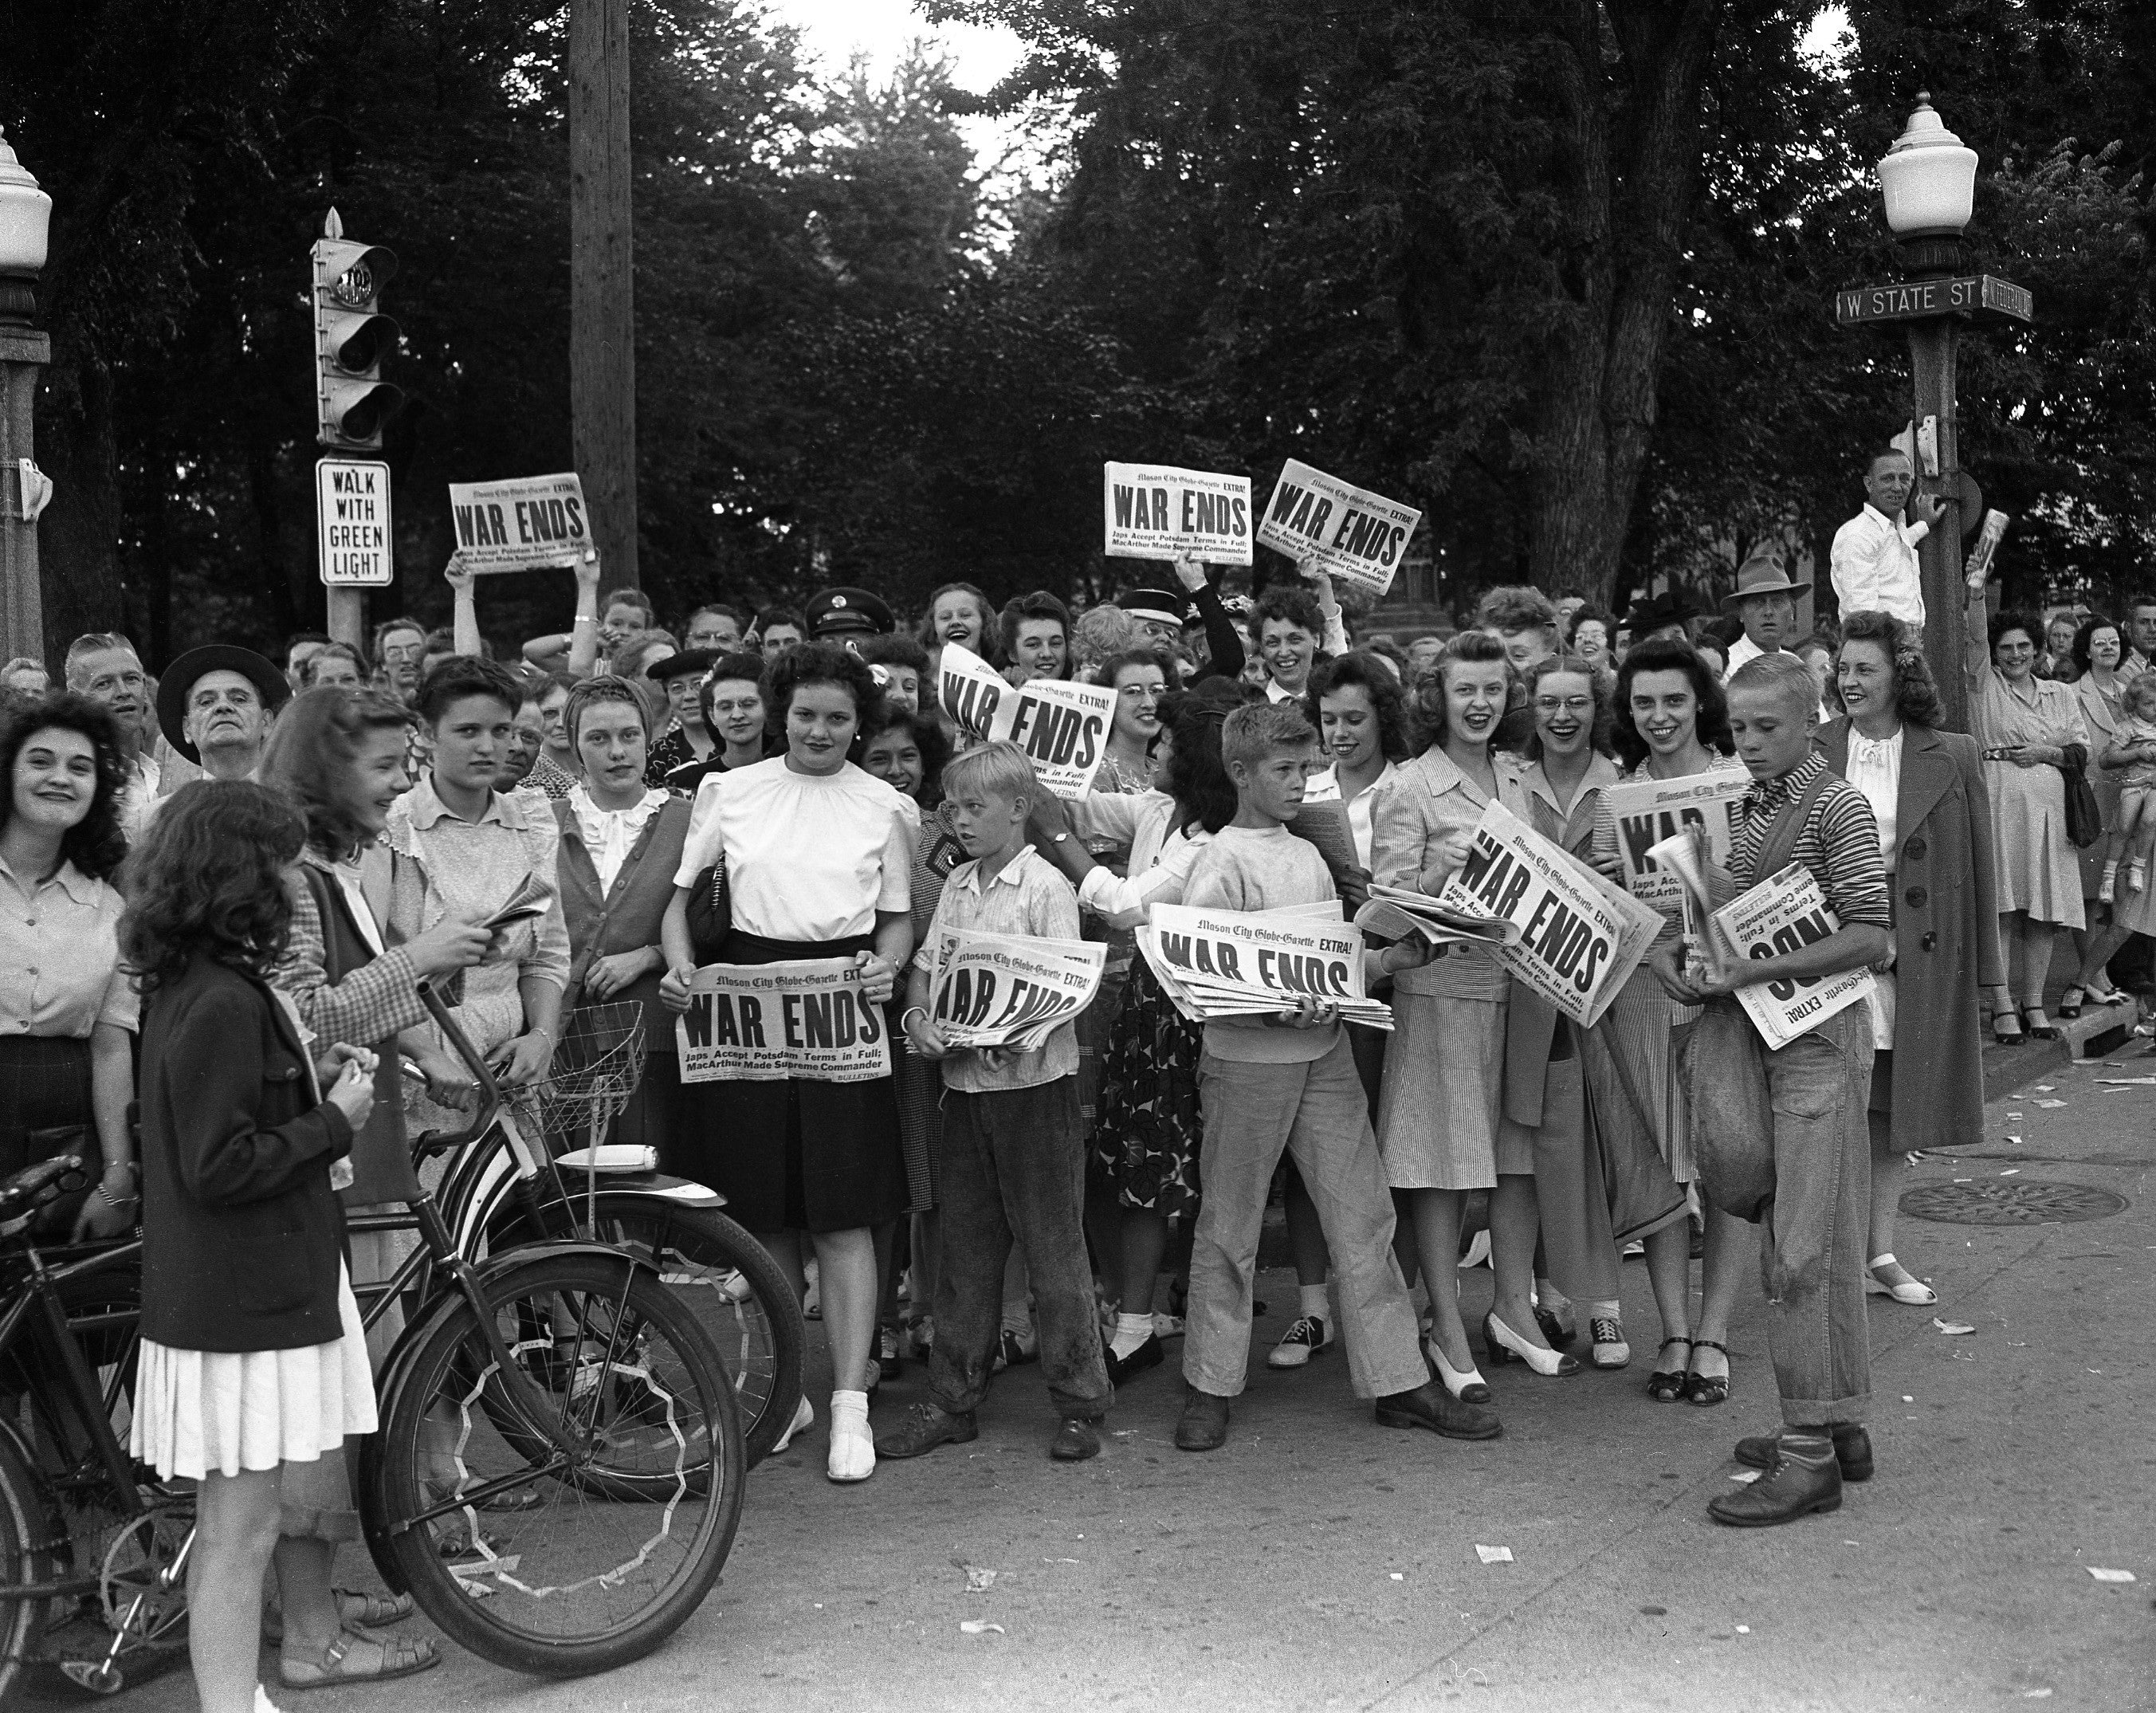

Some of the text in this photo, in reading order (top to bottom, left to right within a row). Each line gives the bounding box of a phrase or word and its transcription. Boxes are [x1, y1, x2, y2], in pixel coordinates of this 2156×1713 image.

[1848, 281, 1976, 317] W STATE ST
[332, 471, 375, 493] WALK
[1223, 483, 1246, 493] EXTRA!
[336, 499, 375, 520] WITH
[1113, 484, 1247, 537] WAR ENDS
[1390, 509, 1413, 525] EXTRA!
[454, 497, 584, 547] WAR ENDS
[1271, 481, 1405, 567] WAR ENDS
[330, 525, 383, 548] GREEN
[1112, 539, 1149, 548] MacArthur
[1172, 543, 1203, 552] Supreme
[1204, 545, 1247, 554] Commander
[1131, 532, 1156, 541] Accept
[1262, 529, 1296, 549] MacArthur
[1315, 553, 1345, 569] Supreme
[1346, 565, 1386, 584] Commander
[1265, 523, 1279, 533] Japs
[1282, 531, 1304, 544] Accept
[1306, 542, 1336, 557] Potsdam
[1339, 553, 1360, 566] Terms
[1373, 567, 1388, 578] Full;
[334, 552, 379, 575] LIGHT
[1079, 693, 1109, 710] EXTRA!
[944, 671, 1103, 769] WAR ENDS
[1036, 777, 1083, 788] ommander
[1513, 835, 1536, 861] Mason
[1537, 857, 1550, 875] City
[1550, 870, 1593, 913] Globe-Gazette
[1633, 877, 1679, 890] Japs Acc
[1448, 885, 1467, 902] Japs
[1459, 829, 1531, 920] WAR
[1521, 889, 1609, 994] ENDS
[1735, 892, 1794, 933] Commander
[1783, 894, 1816, 917] Terms
[1768, 915, 1780, 925] in
[1197, 919, 1353, 955] Mason City Globe-Gazette EXTRA!
[958, 953, 992, 963] Mason
[994, 953, 1011, 968] City
[1011, 957, 1062, 980] Globe-Gazette
[1063, 972, 1090, 990] EXTRA!
[1160, 930, 1248, 983] WAR
[1258, 949, 1353, 997] ENDS
[1526, 955, 1550, 980] Terms
[1553, 979, 1561, 989] in
[717, 976, 751, 988] Mason
[752, 976, 773, 988] City
[775, 974, 838, 988] Globe-Gazette
[1501, 947, 1582, 1014] Supreme Commander
[682, 988, 881, 1049] WAR ENDS
[1785, 996, 1823, 1024] EXTRA!
[685, 1048, 882, 1062] Japs Accept Potsdam Terms in Full;
[686, 1059, 742, 1072] MacArthur
[774, 1060, 819, 1071] Supreme
[820, 1059, 882, 1071] Commander
[838, 1071, 879, 1081] BULLETINS
